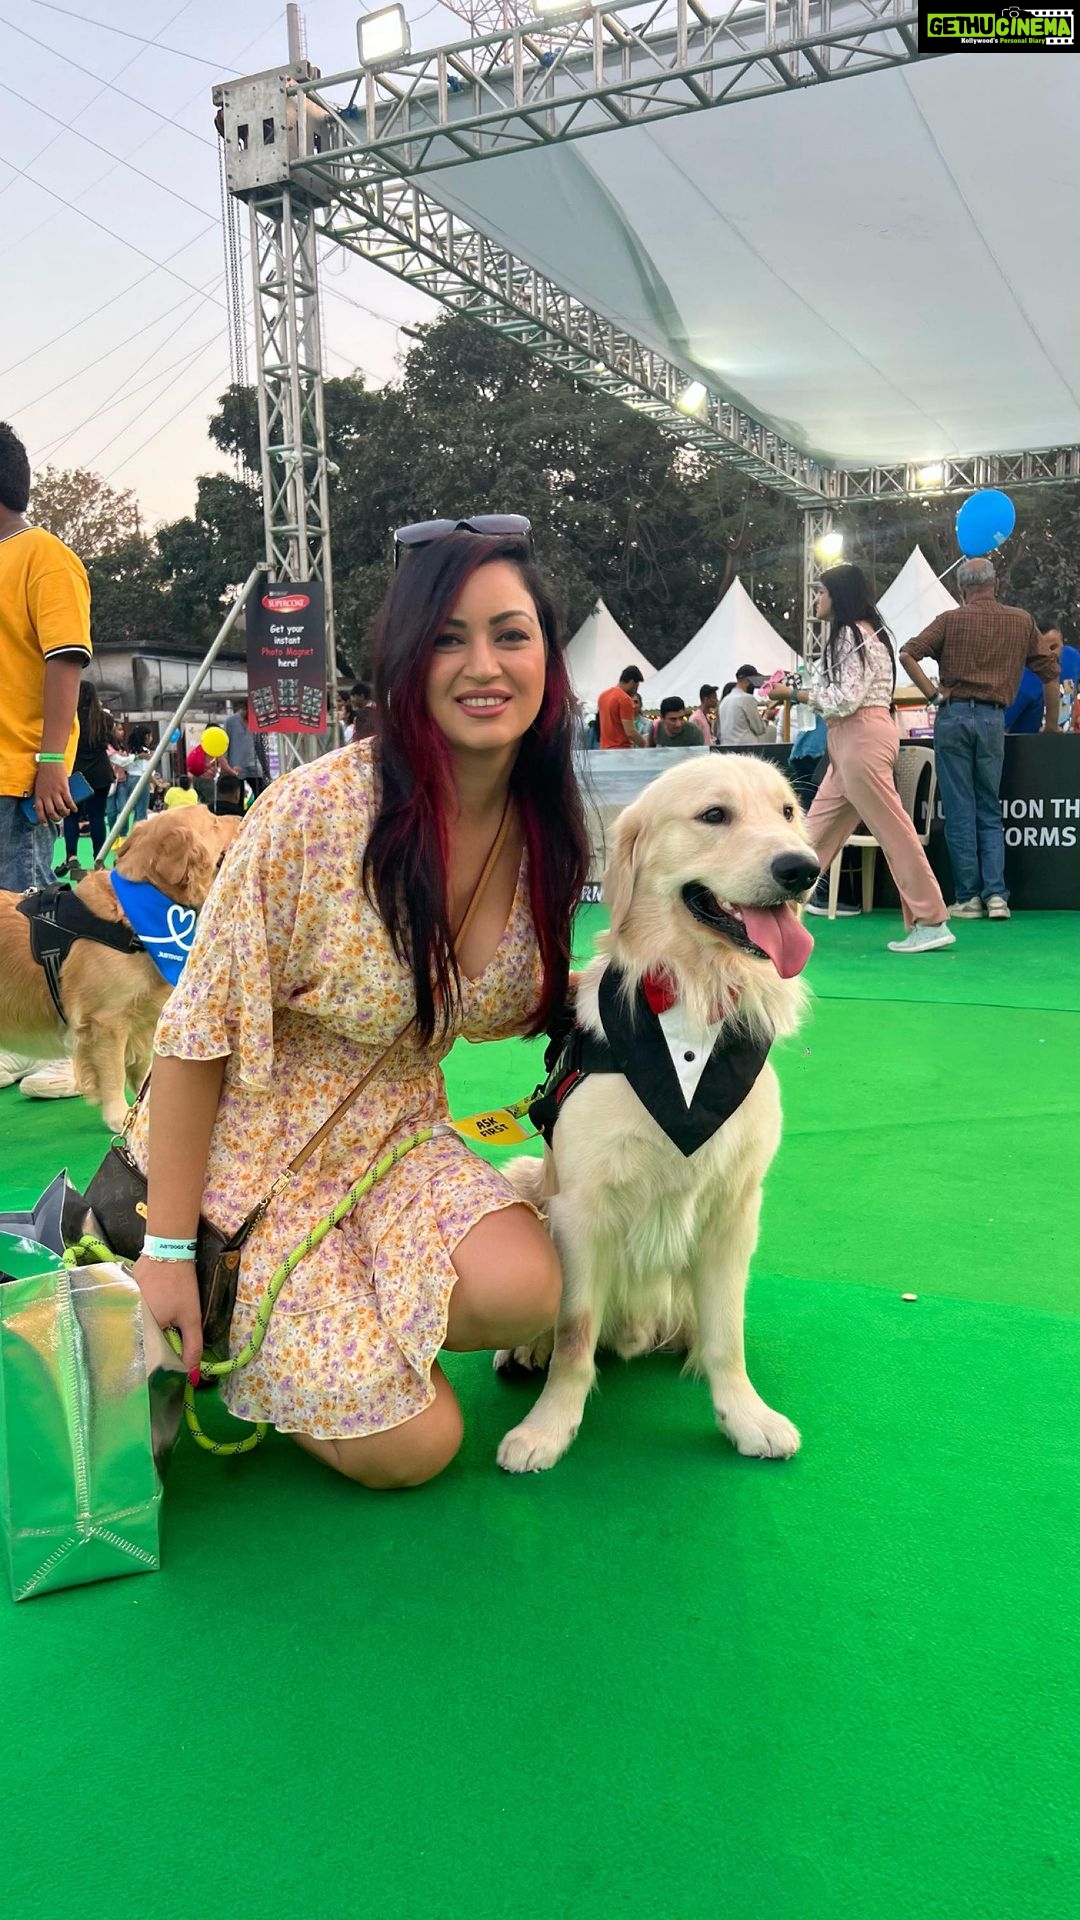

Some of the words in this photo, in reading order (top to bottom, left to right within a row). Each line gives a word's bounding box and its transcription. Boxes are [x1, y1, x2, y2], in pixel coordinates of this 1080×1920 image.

[270, 624, 285, 634] Get
[287, 626, 305, 635] your
[274, 636, 301, 645] instant
[261, 647, 283, 656] Photo
[286, 647, 314, 658] Magnet
[277, 658, 298, 667] here!
[1050, 798, 1080, 819] TH
[475, 1116, 498, 1131] ASK
[480, 1123, 510, 1138] FIRST
